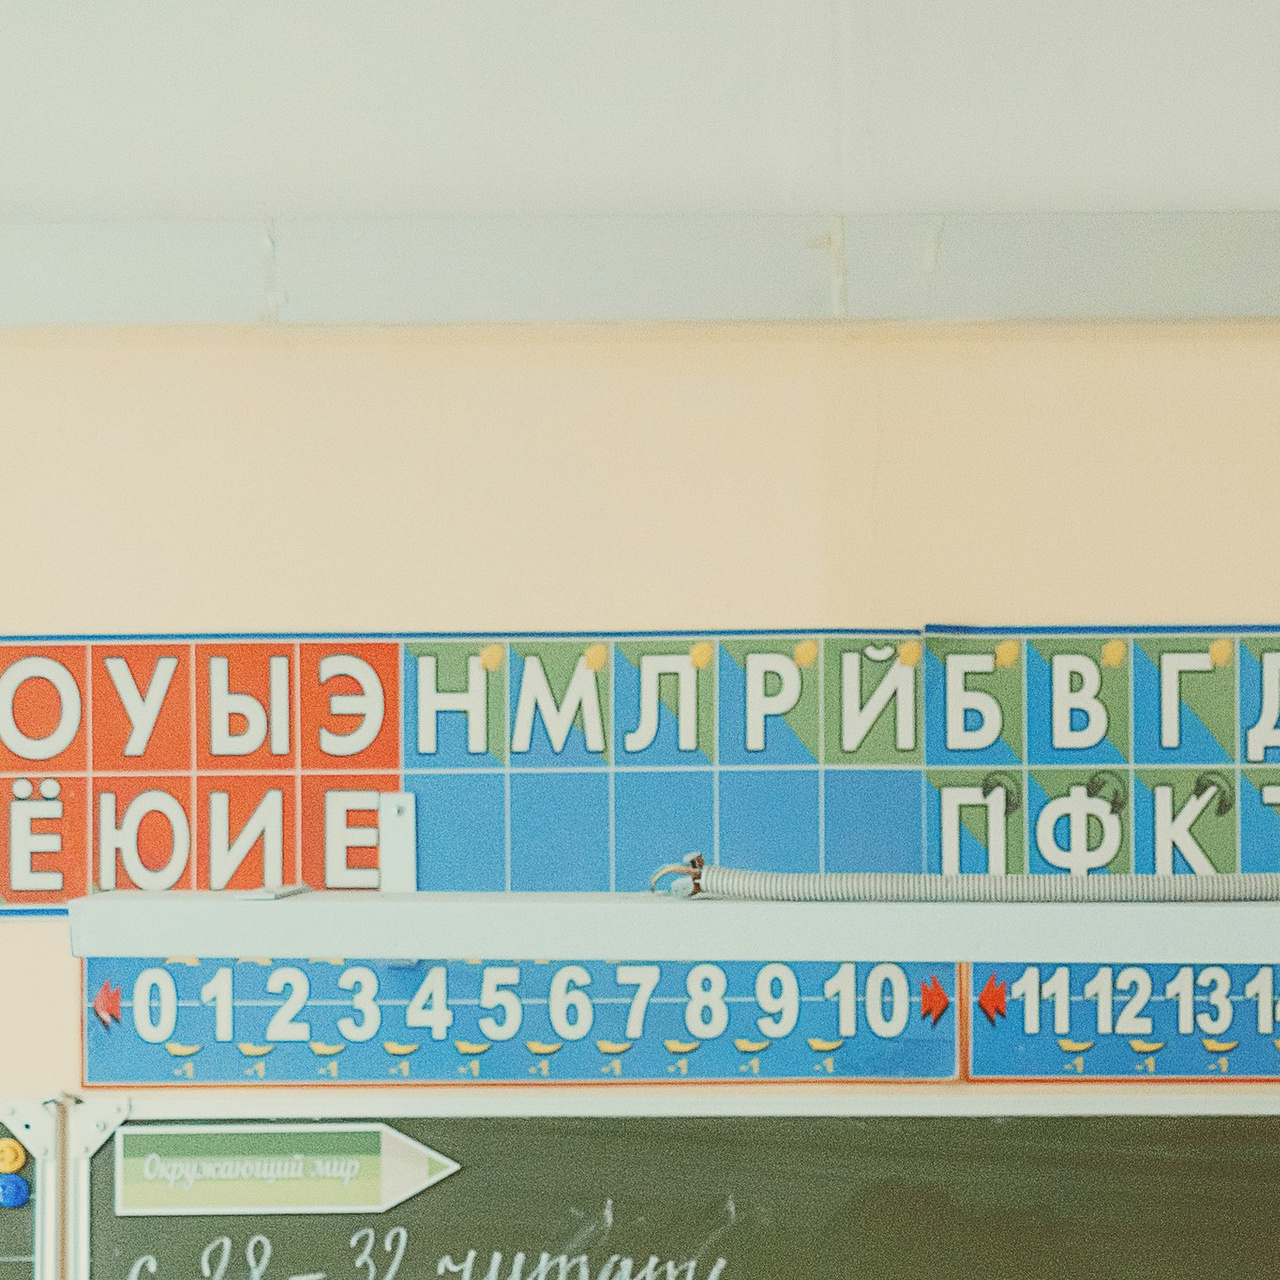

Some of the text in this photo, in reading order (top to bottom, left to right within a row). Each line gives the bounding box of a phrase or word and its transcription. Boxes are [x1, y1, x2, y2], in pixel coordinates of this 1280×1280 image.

[0, 656, 82, 760] О
[104, 657, 179, 757] У
[209, 656, 290, 756] Ы
[319, 654, 385, 757] Э
[416, 655, 488, 754] Н
[511, 654, 606, 753] М
[625, 653, 697, 752] Л
[745, 653, 802, 752] Р
[841, 644, 916, 752] Й
[945, 653, 1003, 751] Б
[1051, 652, 1109, 749] В
[1160, 651, 1214, 748] Г
[10, 778, 63, 891] Ё
[99, 789, 190, 890] Ю
[209, 789, 283, 890] И
[324, 790, 380, 889] Е
[940, 786, 1007, 875] П
[1036, 785, 1122, 876] Ф
[1153, 785, 1220, 875] К
[133, 963, 911, 1043] 0 1 2 3 4 5 6 7 8 9 10
[1010, 966, 1070, 1036] 11
[1084, 966, 1153, 1035] 12
[1165, 966, 1234, 1035] 13
[144, 1153, 361, 1190] Окружающий мир
